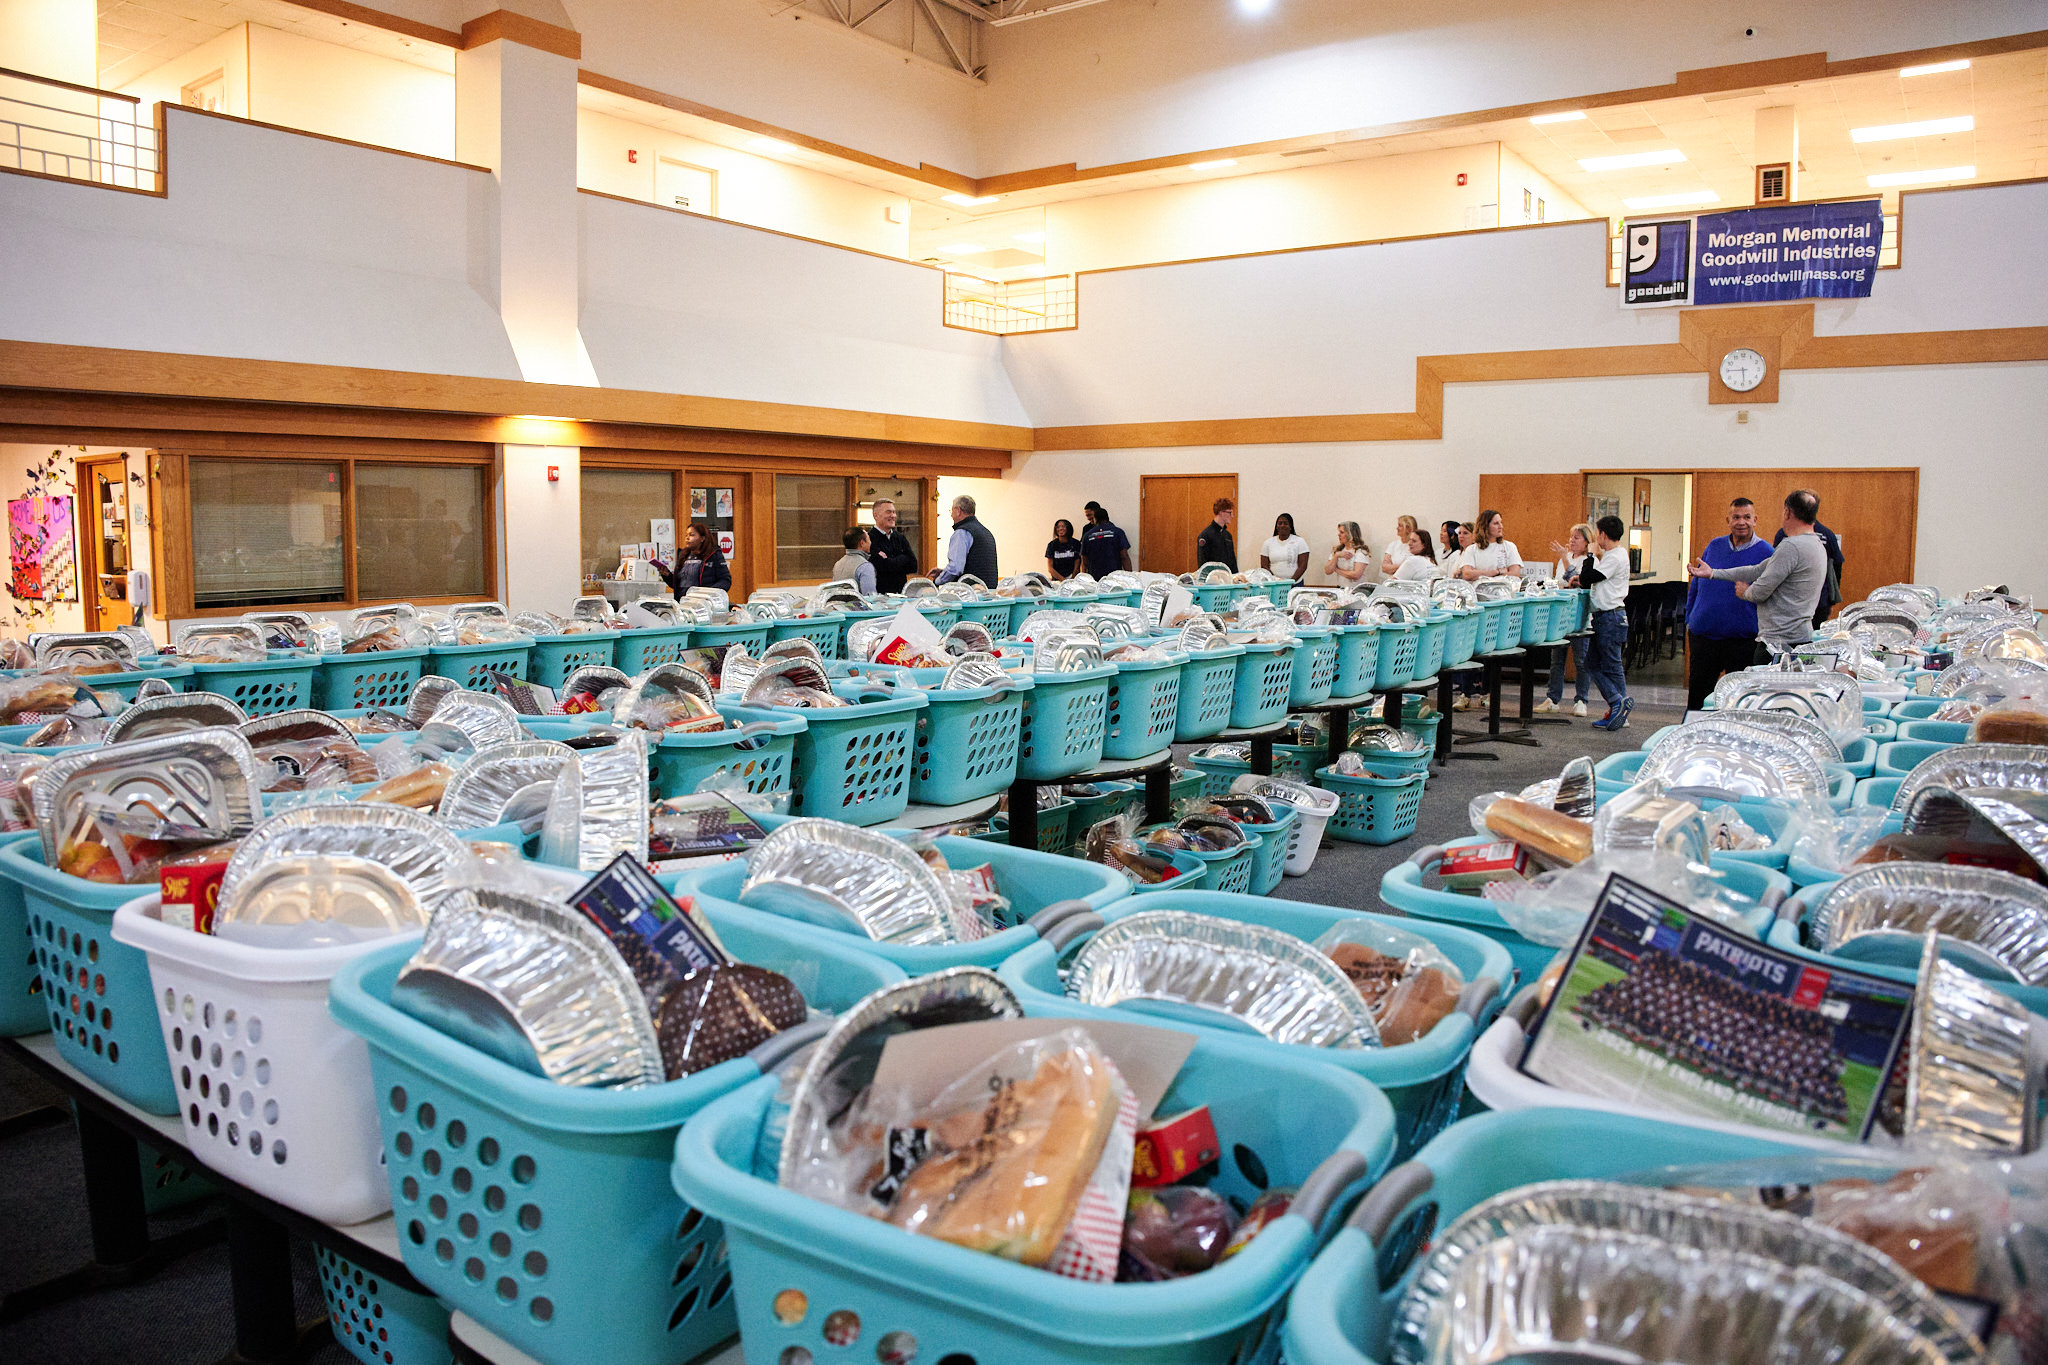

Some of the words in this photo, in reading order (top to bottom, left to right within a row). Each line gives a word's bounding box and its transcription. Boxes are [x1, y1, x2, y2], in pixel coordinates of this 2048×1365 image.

[1708, 232, 1777, 248] Morgan
[1782, 222, 1871, 242] Memorial
[1702, 247, 1778, 267] Goodwill
[1783, 243, 1876, 262] Industries
[1708, 269, 1866, 287] www.goodwillmass.org
[1628, 281, 1685, 301] goodwill
[720, 541, 732, 549] STOP
[1538, 568, 1547, 576] 15
[1693, 931, 1788, 984] PATRIOTS
[1636, 1046, 1668, 1071] NEW
[1668, 1063, 1735, 1101] ENGLAND
[1736, 1092, 1807, 1132] PATRIOTS
